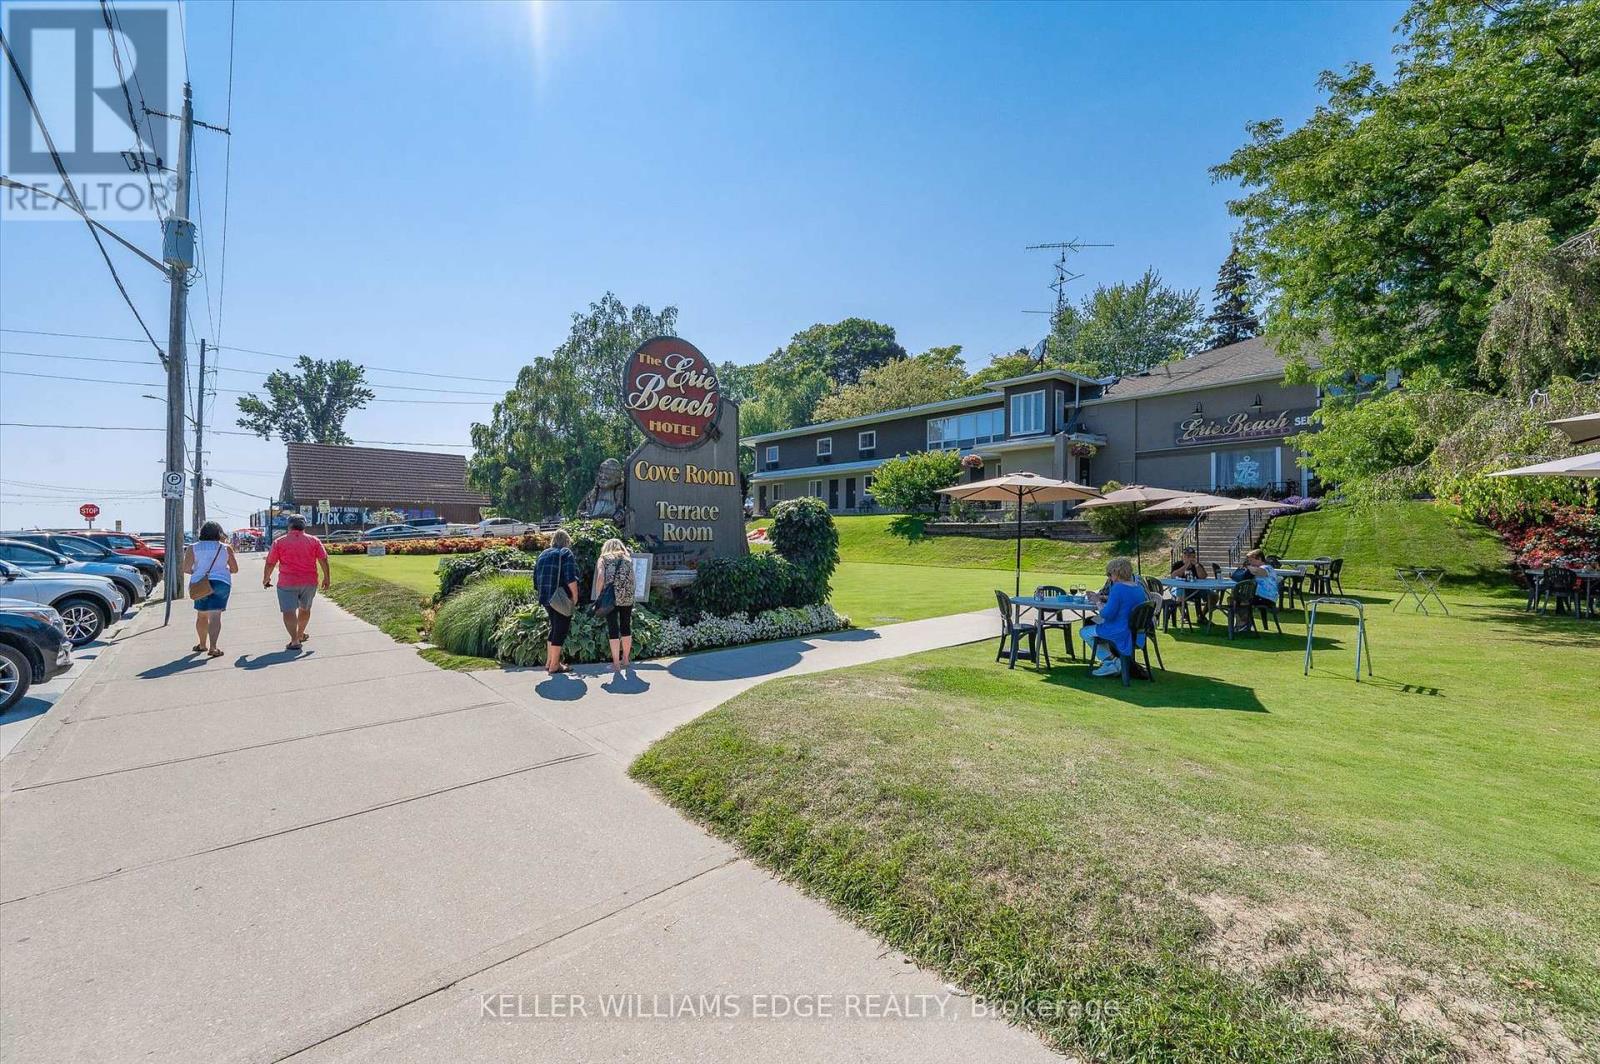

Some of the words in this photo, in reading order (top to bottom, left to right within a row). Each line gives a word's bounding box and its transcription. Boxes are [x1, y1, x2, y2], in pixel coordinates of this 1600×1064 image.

[637, 352, 663, 367] The
[664, 353, 716, 394] Erie
[624, 373, 719, 418] Beach
[649, 420, 699, 437] HOTEL
[1180, 418, 1225, 441] Erie
[1223, 409, 1290, 435] Beach
[634, 460, 680, 483] Cove
[684, 464, 736, 486] Room
[316, 512, 343, 525] JACK.
[655, 501, 720, 521] Terrace
[663, 522, 714, 542] Room
